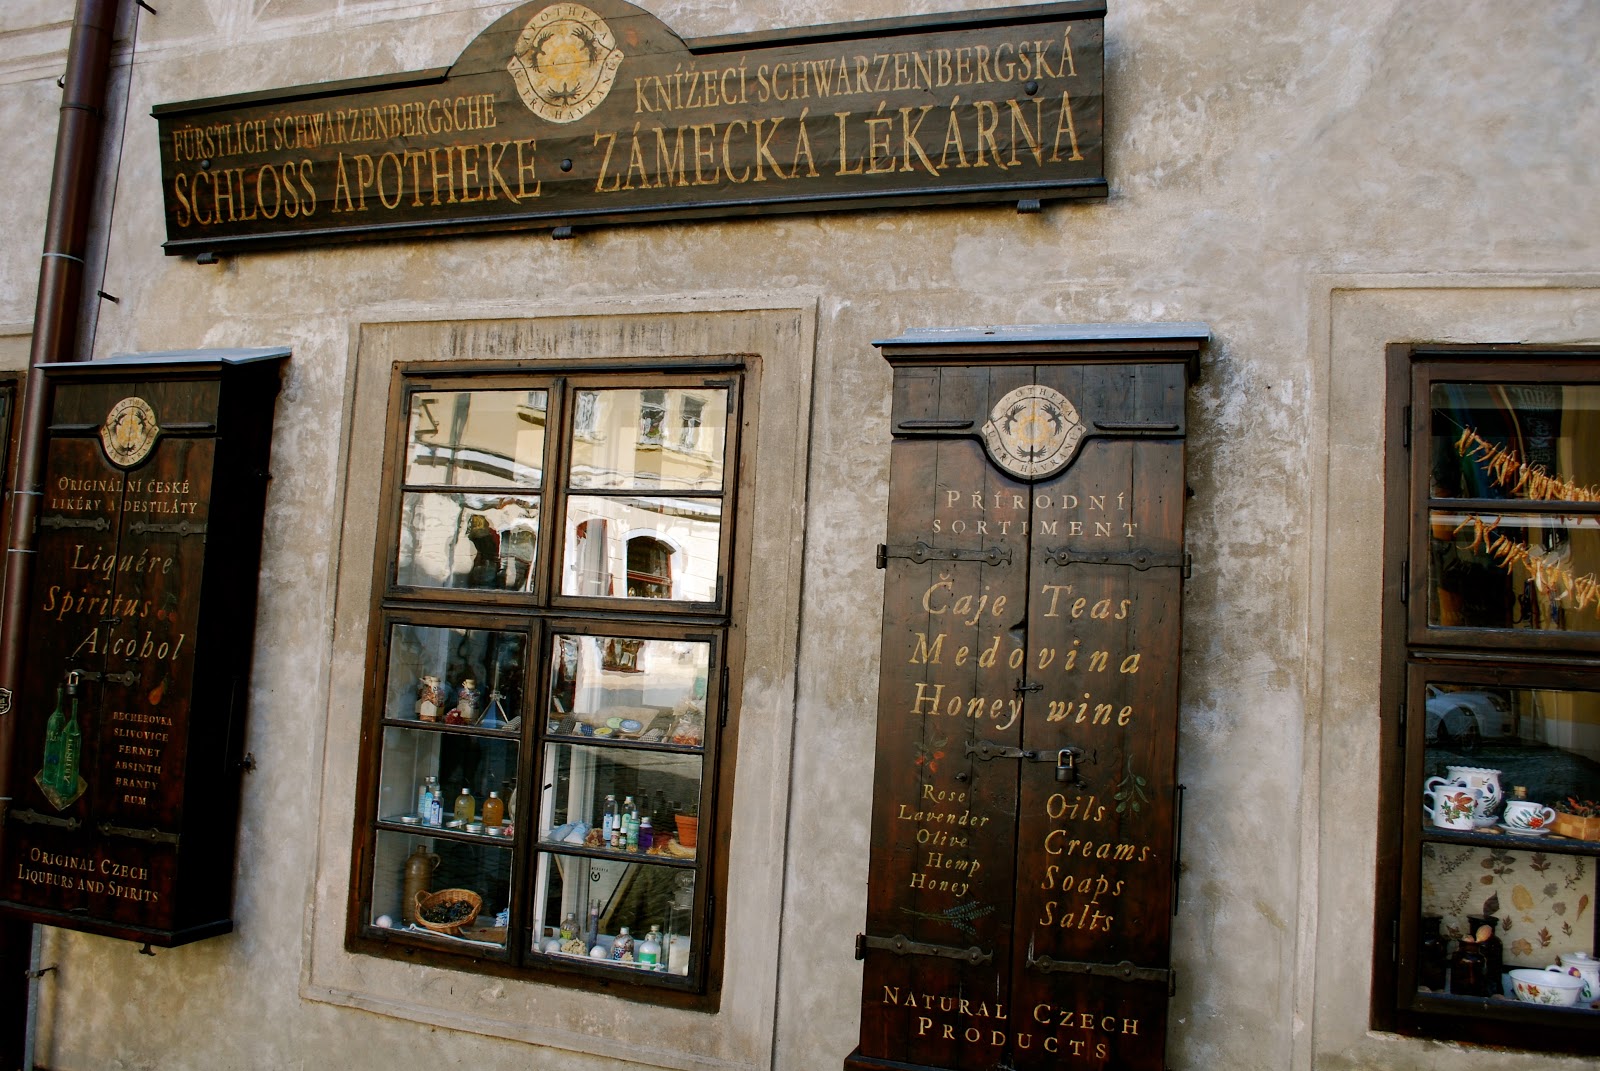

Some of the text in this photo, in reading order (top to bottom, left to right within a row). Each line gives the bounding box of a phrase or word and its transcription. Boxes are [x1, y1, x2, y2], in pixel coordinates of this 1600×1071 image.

[634, 25, 1078, 114] KNÍŽECÍ SCHWARZENBERGSKÁ
[172, 93, 498, 163] FÜRSTLICH SCHWARZENBERGSCHE
[593, 90, 1085, 193] ZÁMECKÁ LÉKÁRNA
[174, 139, 541, 229] SCHLOSS APOTHEKE
[1000, 388, 1073, 417] POTHEKA
[147, 478, 190, 495] ČESKÉ
[946, 489, 1126, 511] PŘÍRODNÍ
[51, 496, 102, 511] LIKÉRY
[123, 499, 198, 515] DESTILÁTY
[932, 518, 1139, 539] SORTIMENT
[70, 544, 174, 581] Liquére
[44, 585, 152, 621] Spiritus
[922, 572, 1132, 627] Čaje Teas
[71, 626, 186, 661] Alcohol
[908, 631, 1141, 675] Medovina
[112, 711, 173, 726] BECHEROVKA
[909, 681, 1133, 731] Honey wine
[113, 727, 169, 742] SLIVOVICE
[115, 760, 162, 775] ABSINTH
[118, 745, 162, 758] FERNET
[115, 777, 159, 791] BRANDY
[124, 794, 147, 806] RUM
[922, 783, 966, 805] Rose
[898, 803, 990, 827] Lavender
[1045, 792, 1106, 823] Oils
[916, 828, 968, 848] Olive
[1044, 829, 1151, 863] Creams
[30, 847, 149, 881] ORIGINAL CZECH
[925, 851, 980, 878] Hemp
[18, 863, 159, 904] LIQUEURS AND SPIRITS
[909, 872, 970, 898] Honey
[1040, 865, 1125, 905] Soaps
[1039, 900, 1115, 933] Salts
[882, 985, 1140, 1035] NATURAL CZECH
[918, 1016, 1107, 1060] PRODUCTS
